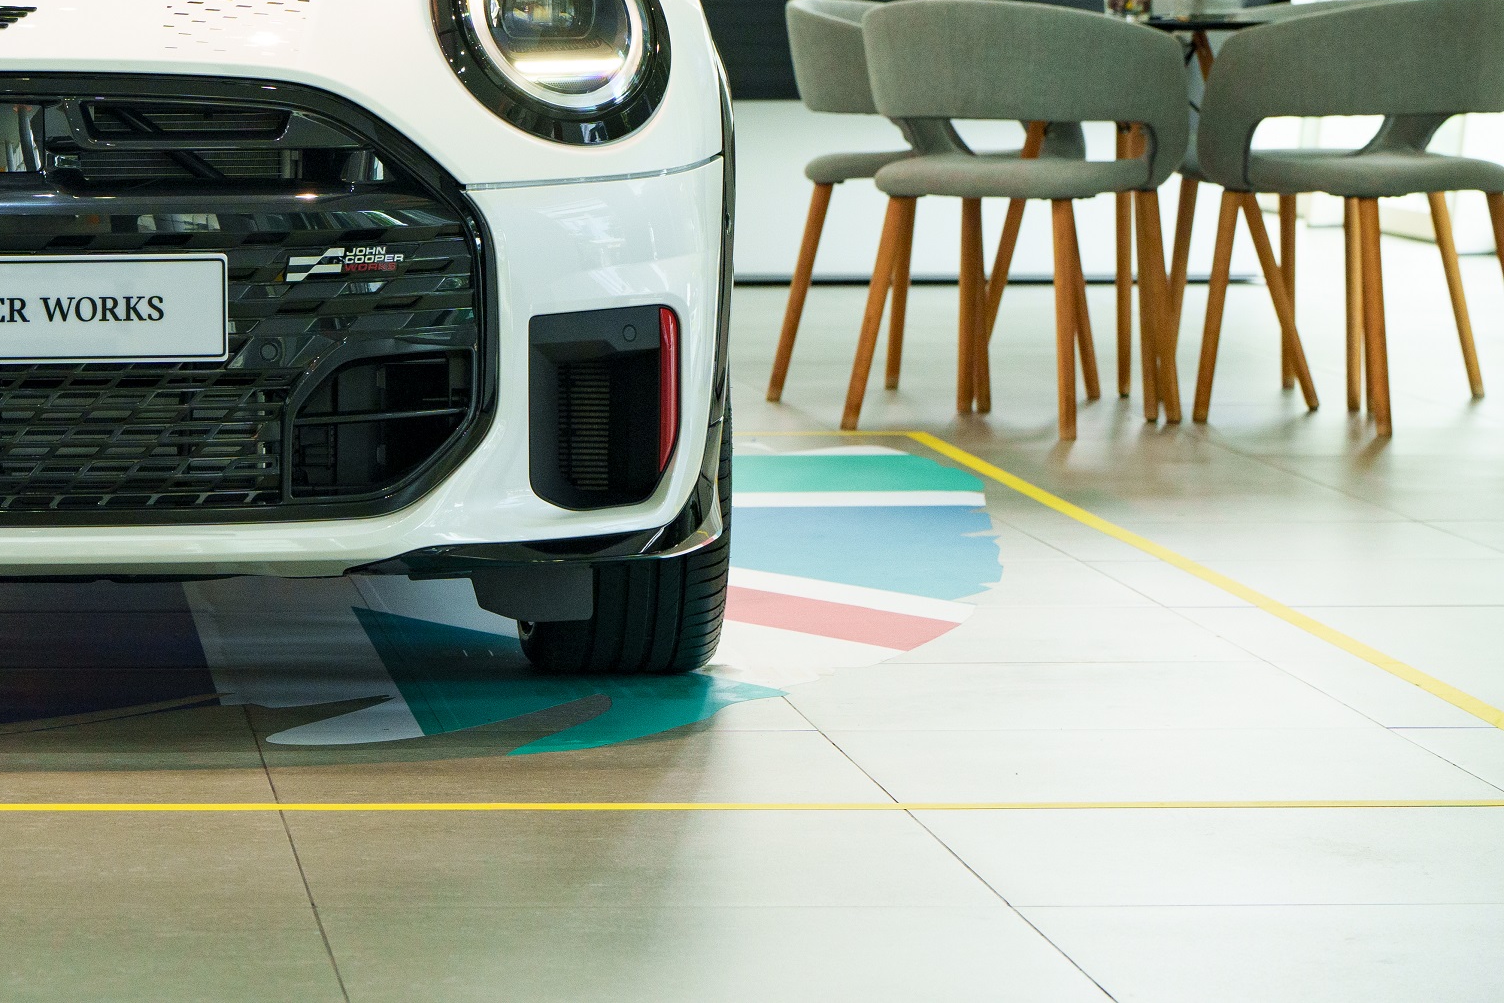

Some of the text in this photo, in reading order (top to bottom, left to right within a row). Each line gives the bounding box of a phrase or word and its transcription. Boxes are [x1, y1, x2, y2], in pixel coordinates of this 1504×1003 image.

[346, 246, 386, 255] JOHN
[344, 254, 404, 264] COOPER
[344, 262, 396, 271] WORKS
[40, 295, 165, 322] WORKS
